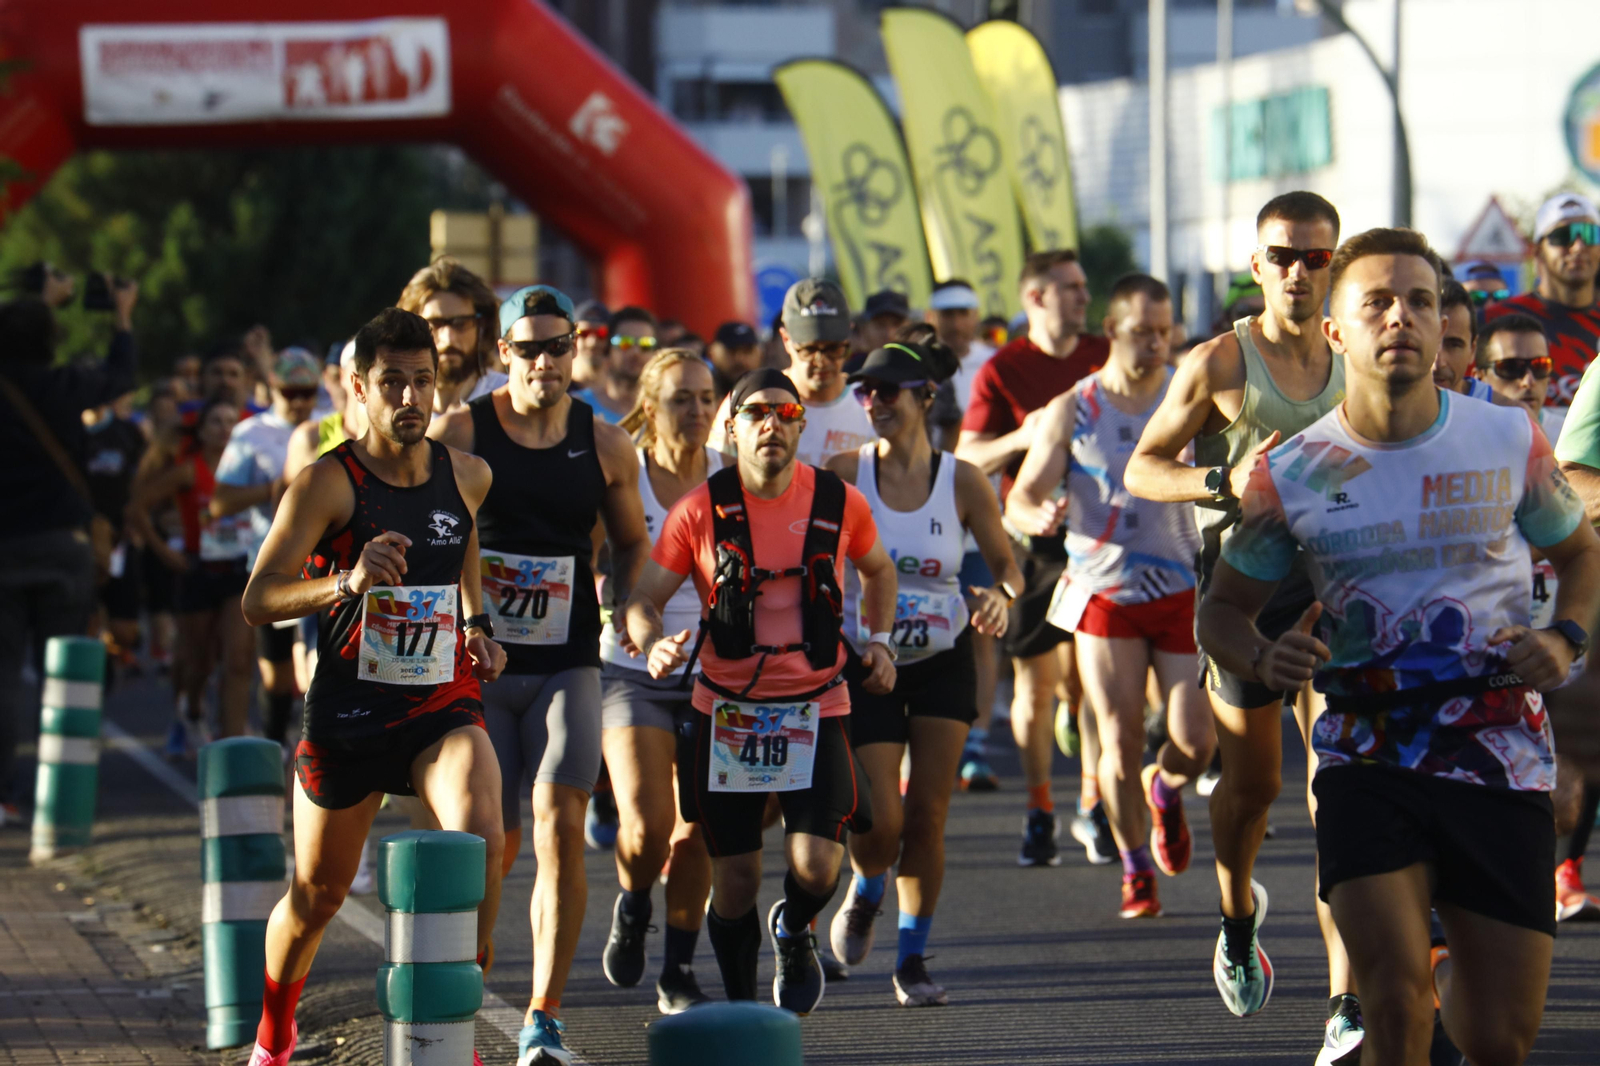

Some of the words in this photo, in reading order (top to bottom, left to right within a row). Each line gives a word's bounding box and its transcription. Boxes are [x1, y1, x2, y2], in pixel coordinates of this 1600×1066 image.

[1421, 466, 1512, 510] MEDIA
[498, 586, 549, 620] 270
[396, 622, 439, 657] 177
[892, 619, 929, 648] 23
[740, 735, 789, 767] 419
